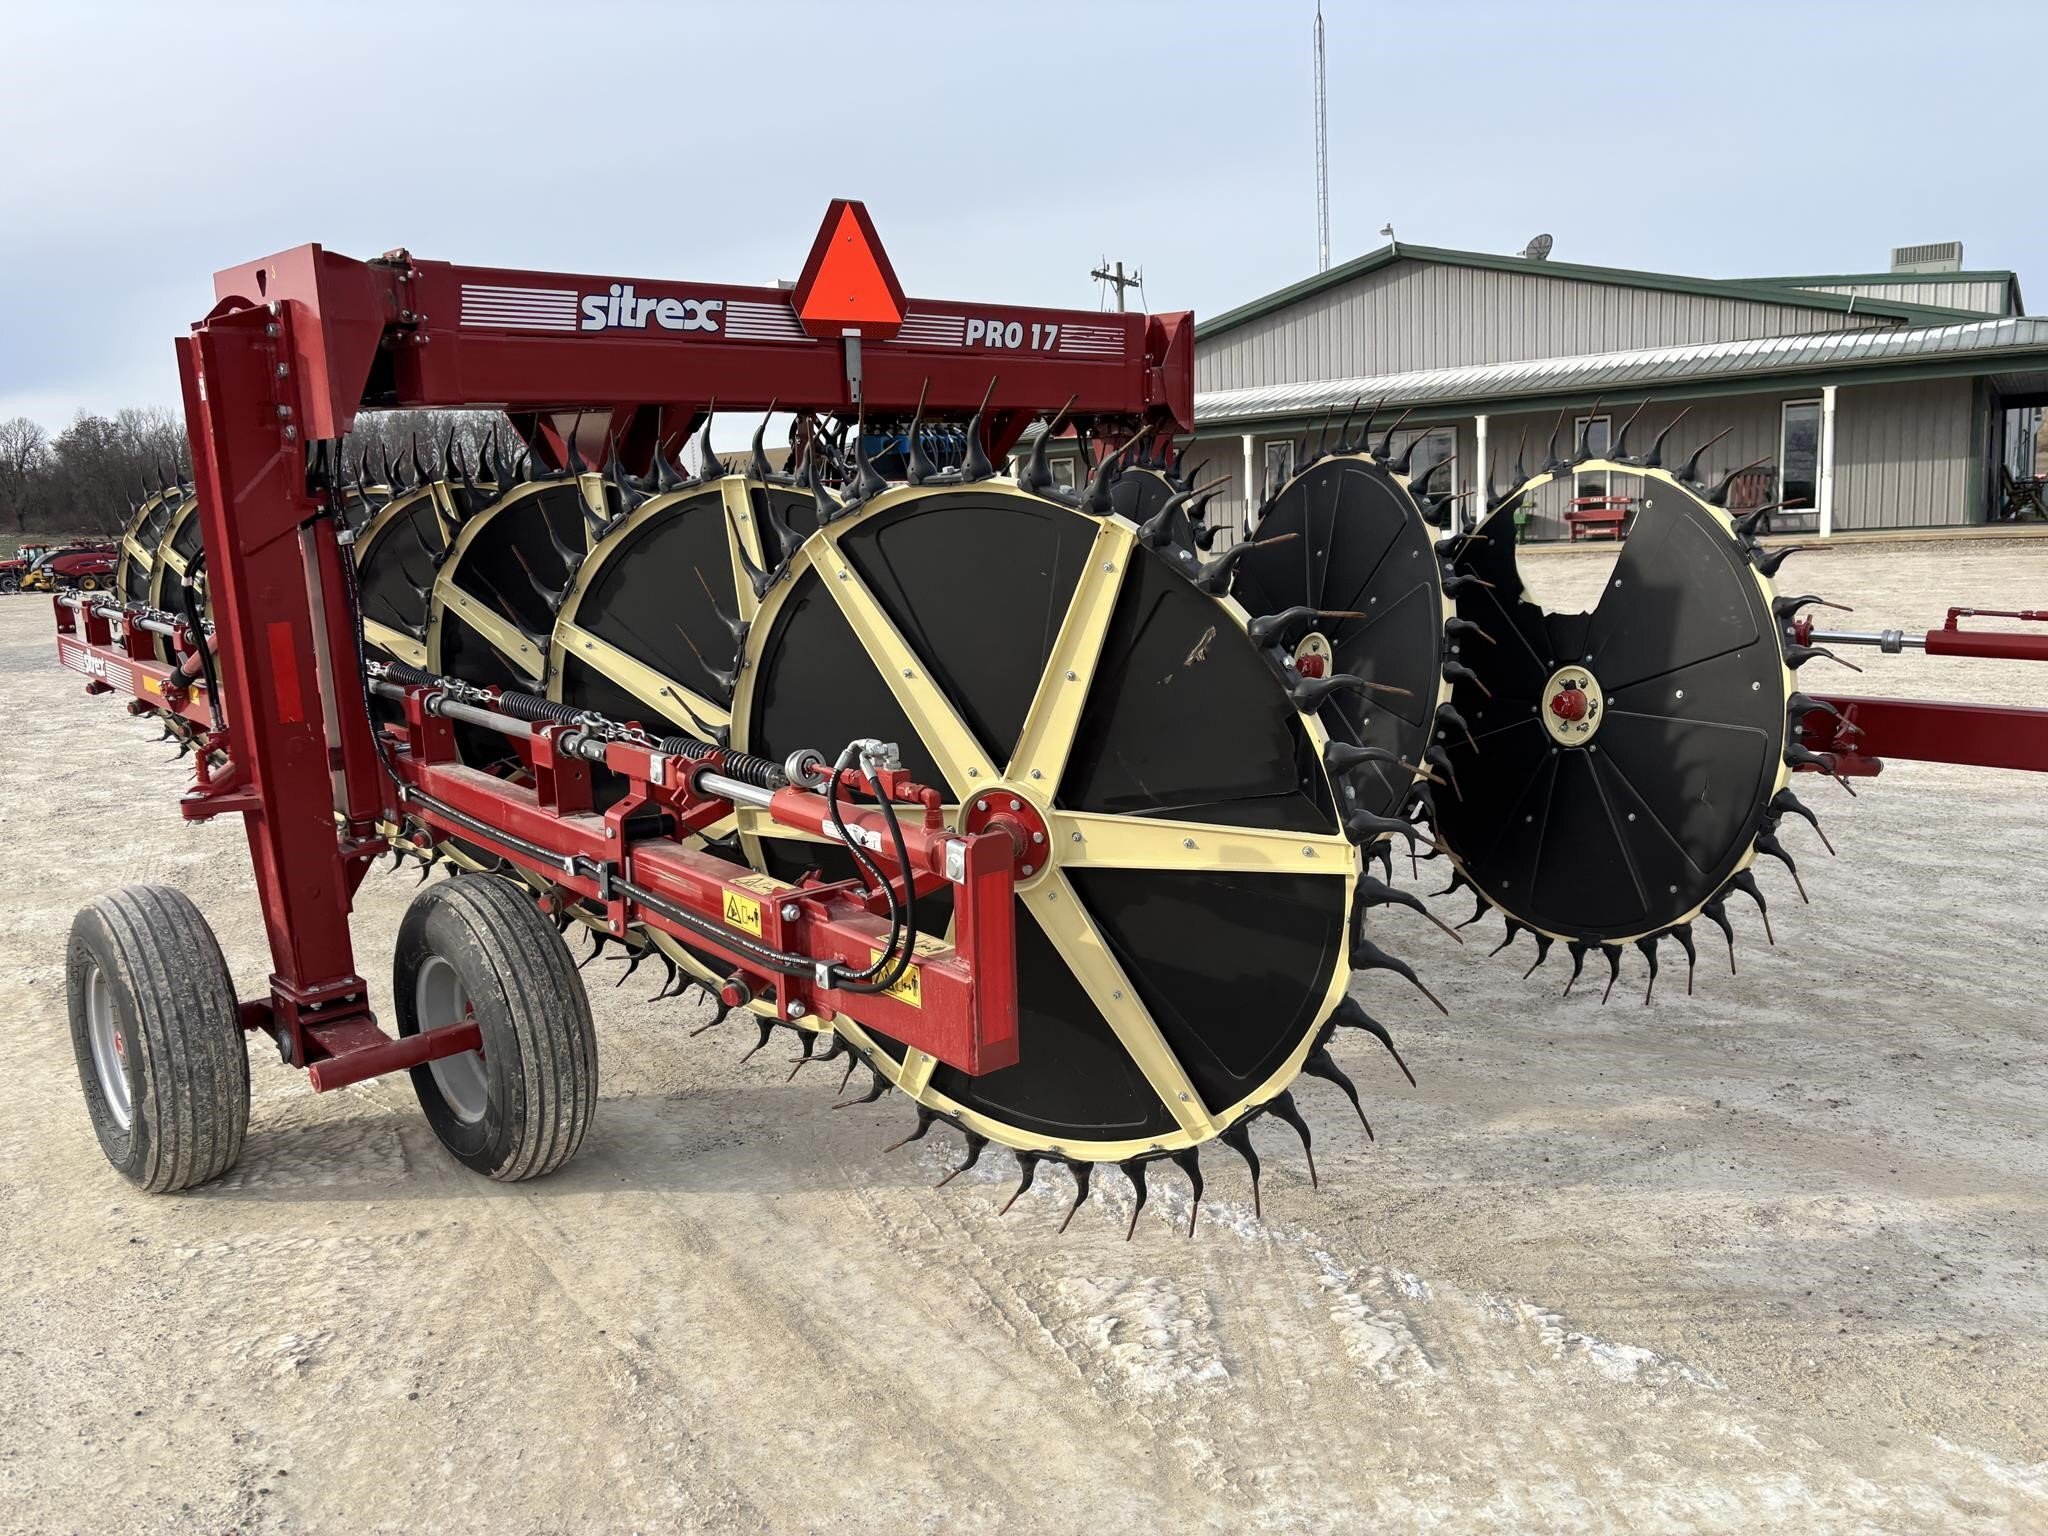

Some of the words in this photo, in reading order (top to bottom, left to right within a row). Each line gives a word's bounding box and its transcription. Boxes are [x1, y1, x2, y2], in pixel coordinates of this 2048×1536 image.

[580, 283, 723, 332] sitrex
[965, 319, 1023, 349] PRO
[1031, 323, 1059, 351] 17
